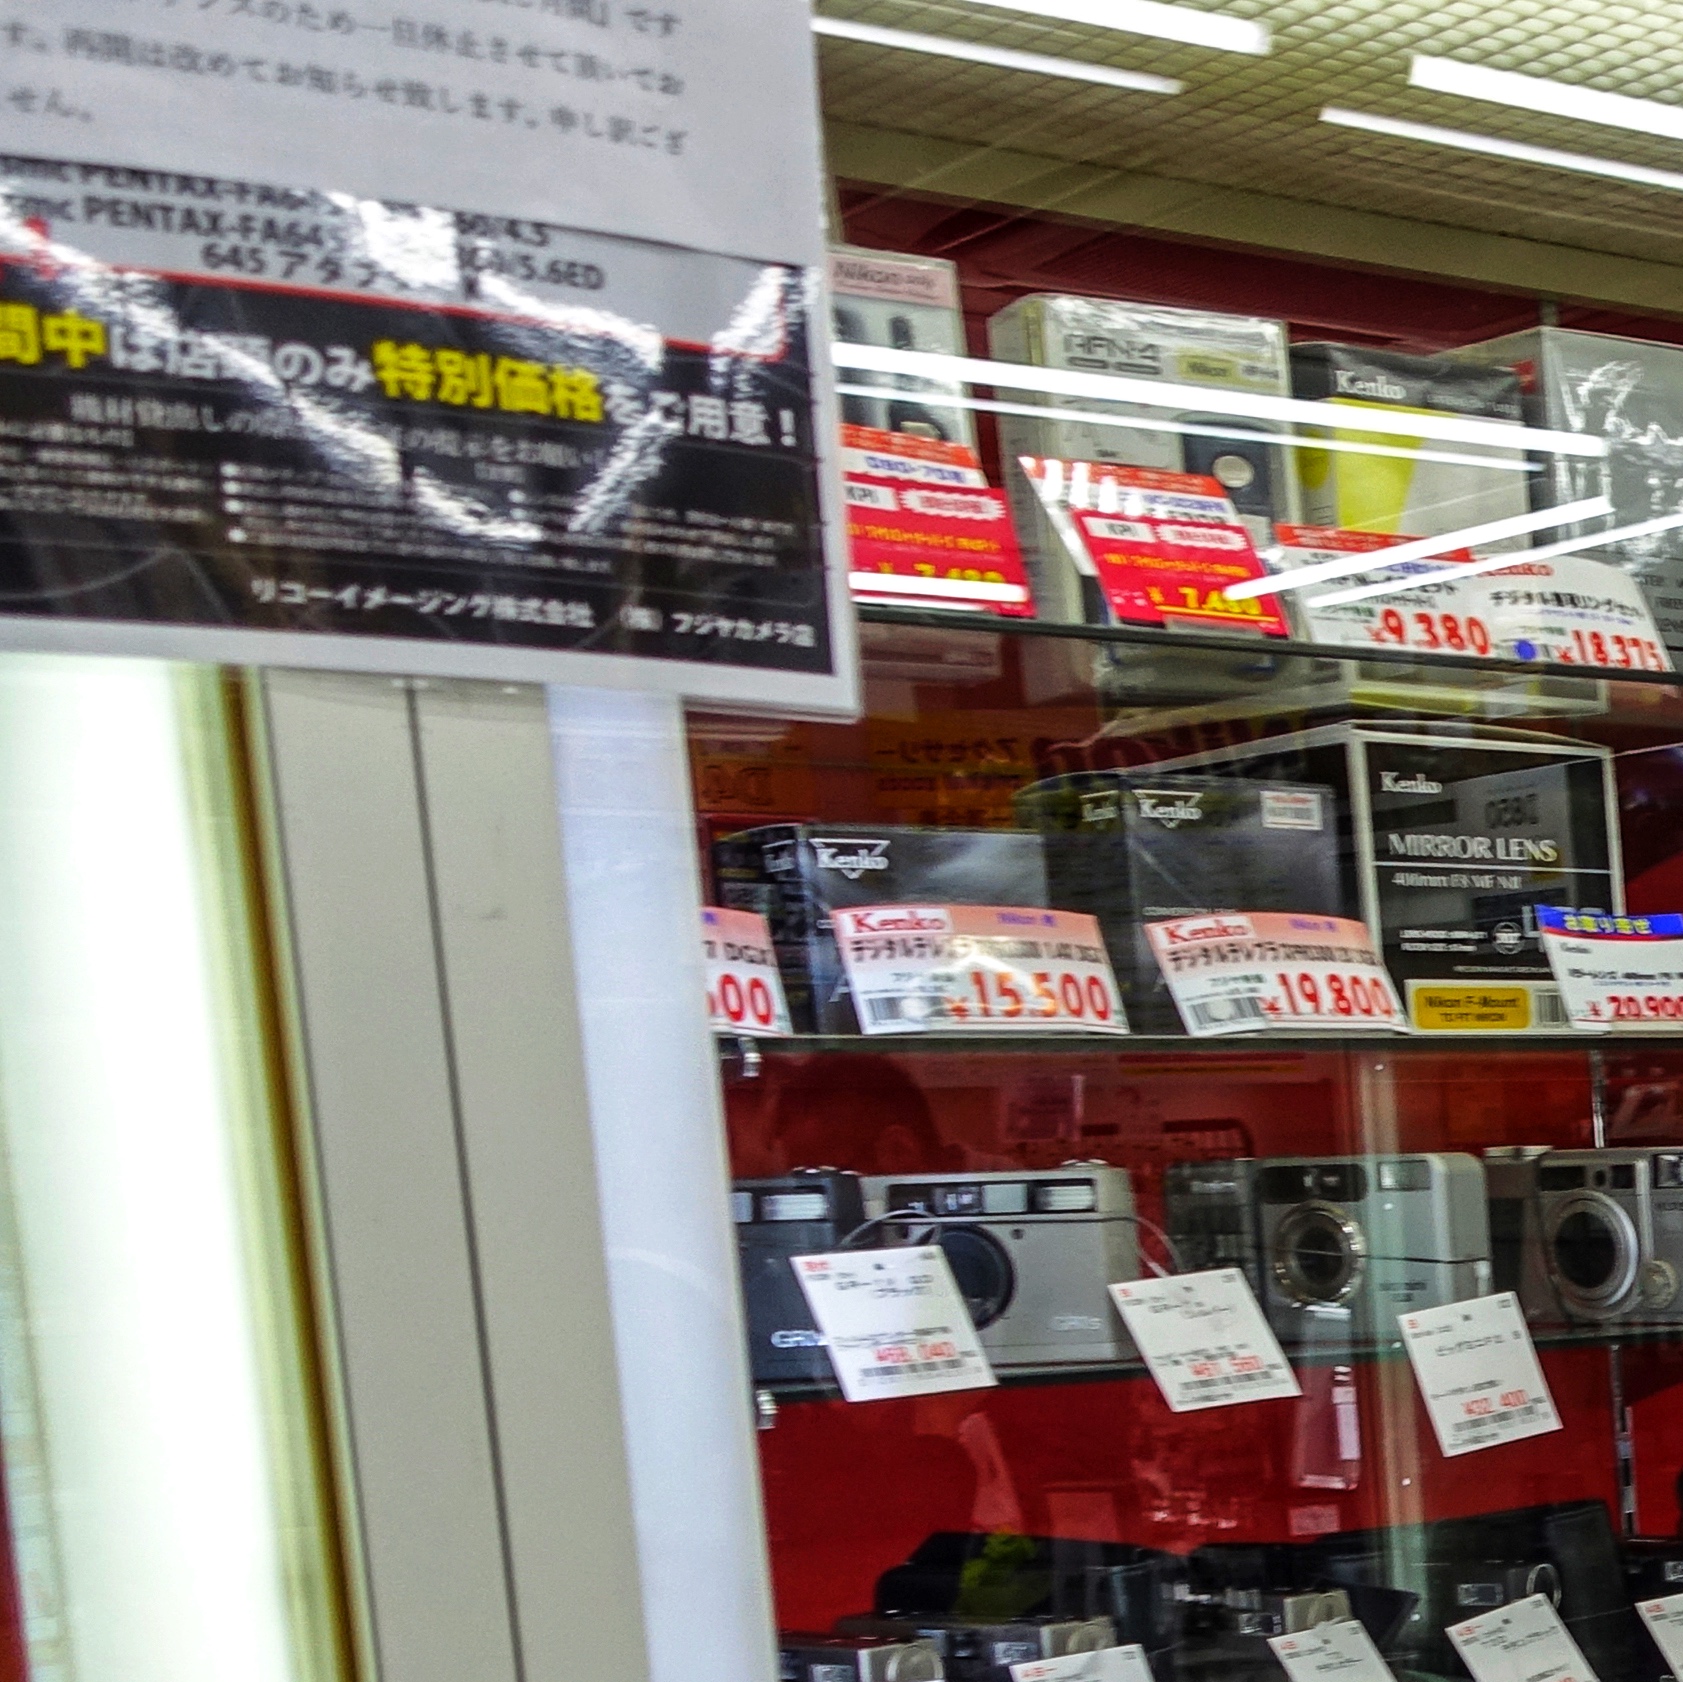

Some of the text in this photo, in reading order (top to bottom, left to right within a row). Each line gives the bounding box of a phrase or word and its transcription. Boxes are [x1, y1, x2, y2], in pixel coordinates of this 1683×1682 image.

[1334, 371, 1408, 400] Kenko
[1380, 771, 1443, 795] Kenko
[1138, 799, 1203, 820] Kenko
[816, 848, 890, 870] Kenko
[1389, 833, 1558, 863] MIRROR LENS
[850, 910, 947, 934] Kenko
[1164, 917, 1254, 943] Kenko
[945, 969, 1112, 1022] ¥15,500
[1260, 972, 1397, 1018] ¥19,800
